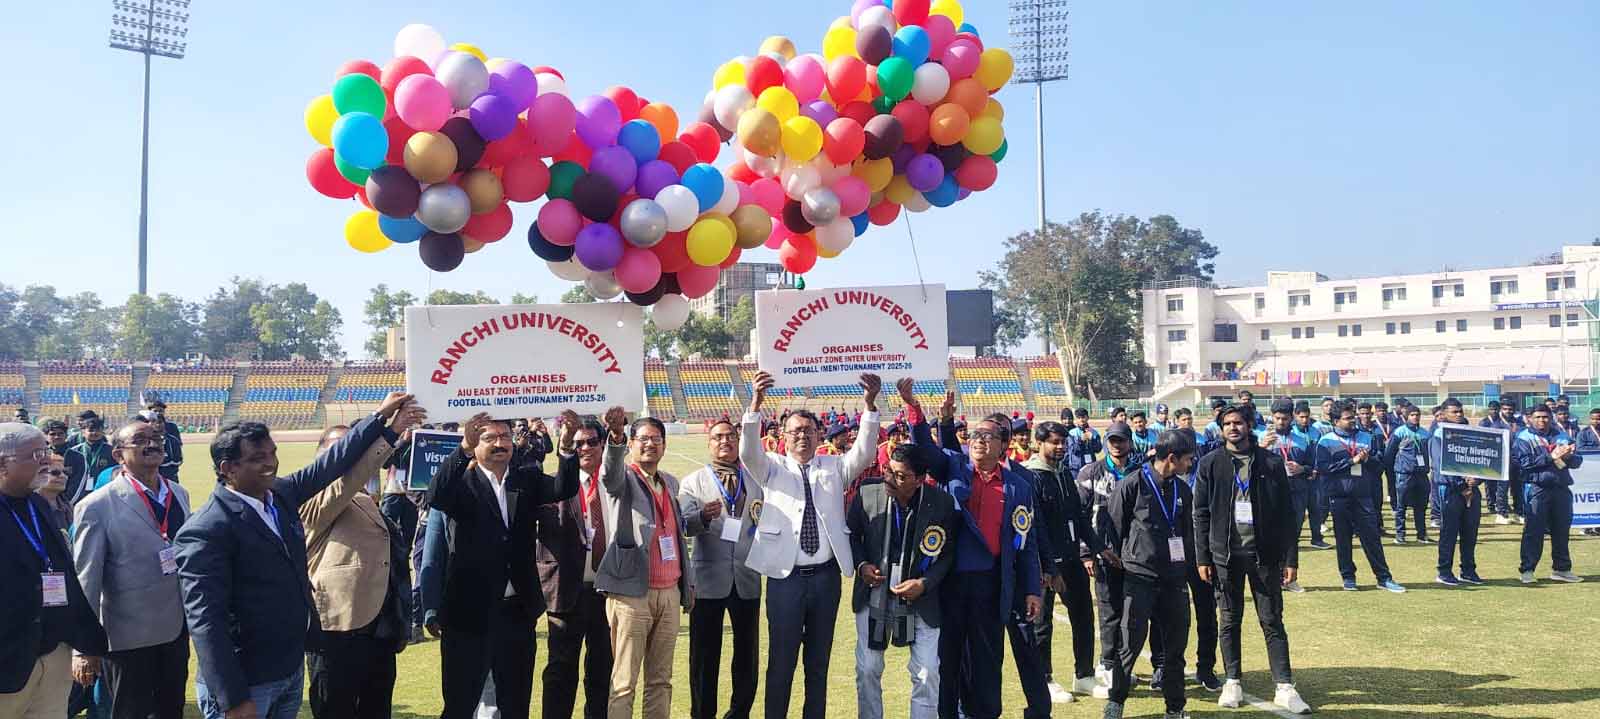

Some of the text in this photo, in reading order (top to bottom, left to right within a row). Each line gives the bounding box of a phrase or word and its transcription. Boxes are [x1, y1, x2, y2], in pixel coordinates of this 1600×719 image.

[773, 291, 929, 353] RANCHI UNIVERSITY
[431, 312, 622, 385] RANCHI UNIVERSITY
[822, 343, 884, 354] ORGANISES
[792, 354, 906, 365] AIU EAST ZONE INTER UNIVERSITY
[784, 366, 818, 375] FOOTBALL
[887, 362, 913, 370] 2025-26
[490, 374, 567, 385] ORGANISES
[457, 384, 598, 397] AIU EAST ZONE INTER UNIVERSITY
[447, 397, 491, 408] FOOTBALL
[575, 394, 606, 403] 2025-26
[424, 451, 448, 463] Visv
[1447, 443, 1498, 458] Sister Nivedita
[1455, 453, 1491, 467] University
